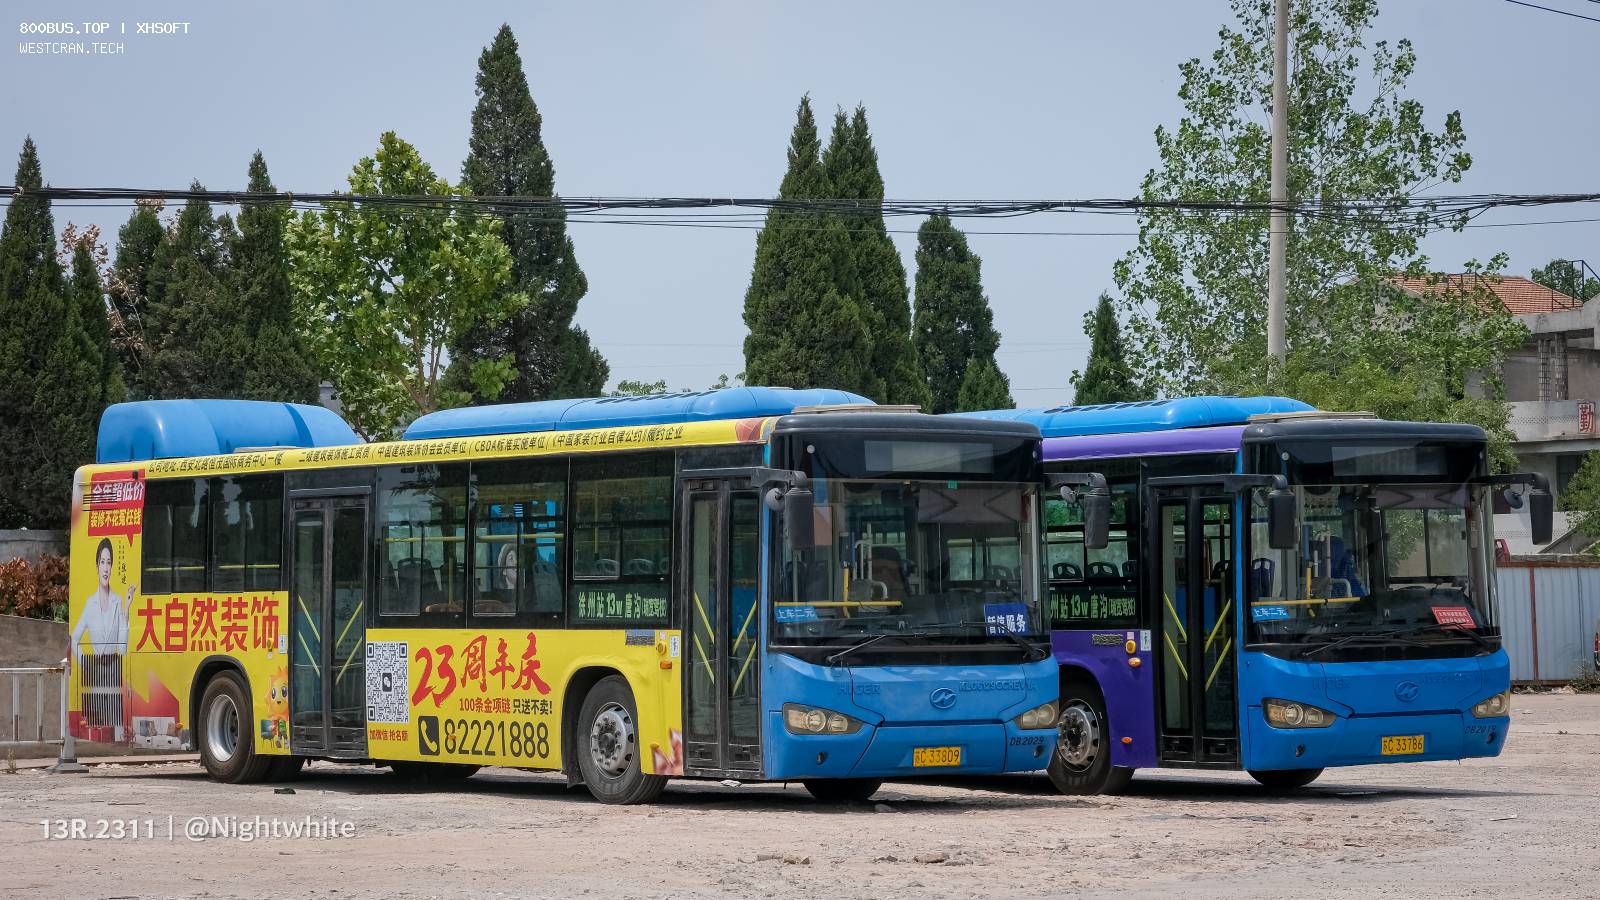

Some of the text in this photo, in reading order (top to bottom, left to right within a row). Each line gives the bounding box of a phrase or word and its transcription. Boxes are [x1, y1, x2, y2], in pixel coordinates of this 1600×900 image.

[136, 596, 279, 652] 大自然装饰
[411, 632, 552, 708] 23周年庆
[444, 718, 550, 759] 82221888
